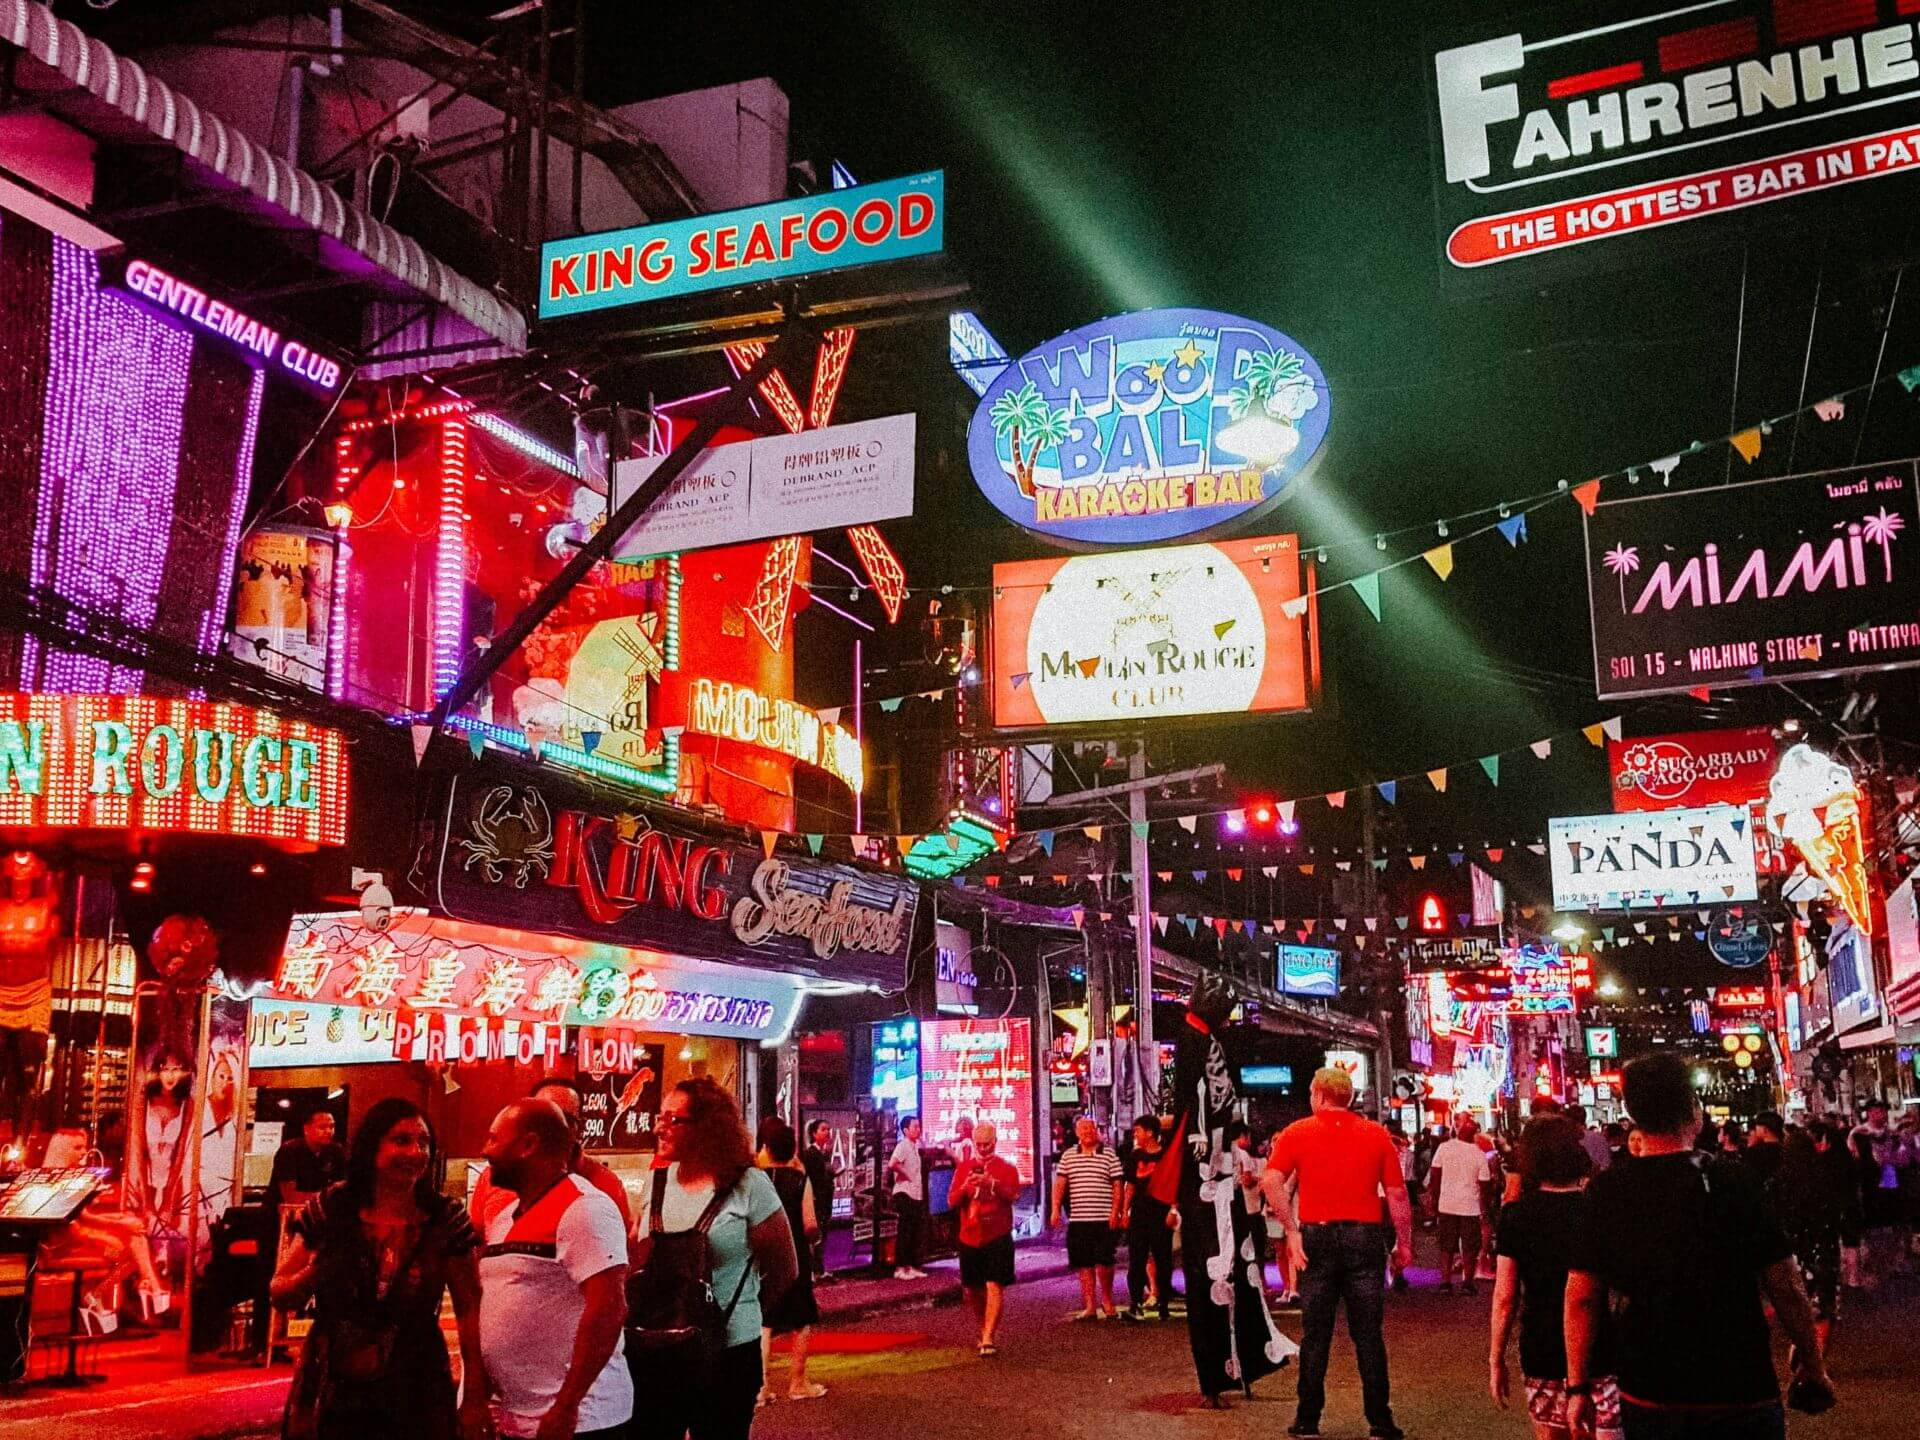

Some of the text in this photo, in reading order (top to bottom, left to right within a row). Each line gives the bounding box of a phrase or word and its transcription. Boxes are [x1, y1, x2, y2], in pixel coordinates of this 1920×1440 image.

[1436, 22, 1920, 184] FAHRENHE
[1490, 215, 1557, 251] THE
[1566, 182, 1723, 236] HOTTEST
[1732, 162, 1807, 200] BAR
[1815, 147, 1854, 182] IN
[548, 192, 937, 301] KING SEAFOOD
[125, 259, 341, 390] GENTLEMAN CLUB
[649, 499, 700, 513] EBRAND
[1035, 471, 1265, 523] KARAOKE BAR
[1610, 656, 1636, 679] SOI
[1644, 652, 1666, 677] 15
[1766, 634, 1823, 662] STREET
[88, 720, 318, 811] ROUGE
[1655, 766, 1735, 787] AGO-GO
[1656, 748, 1771, 772] SUGARBABY
[1569, 834, 1736, 875] PANDA
